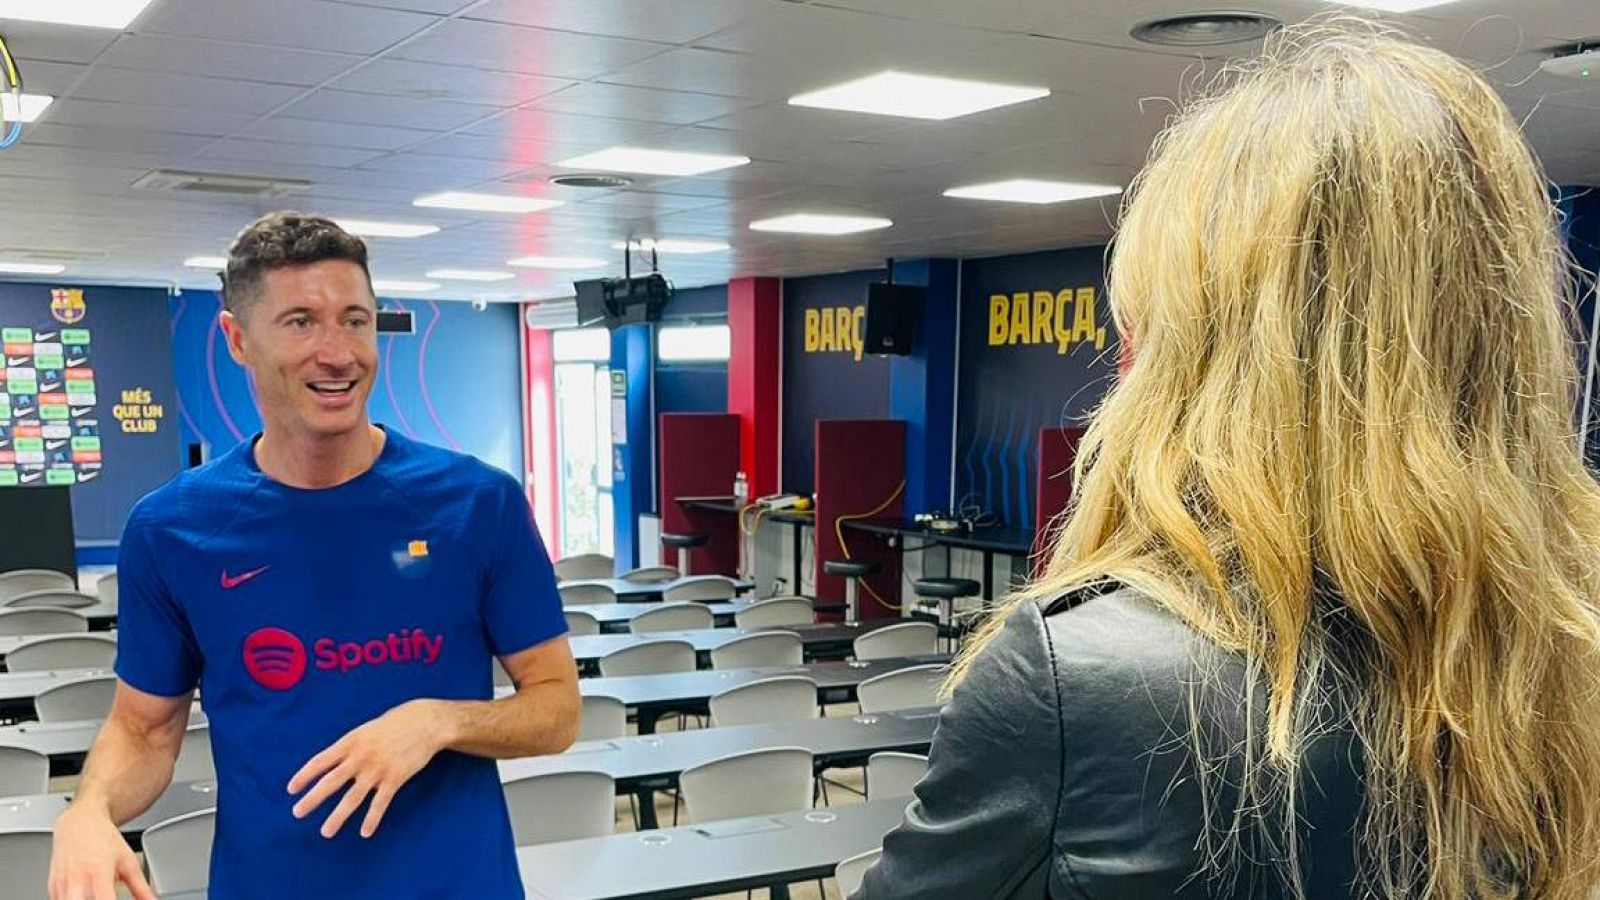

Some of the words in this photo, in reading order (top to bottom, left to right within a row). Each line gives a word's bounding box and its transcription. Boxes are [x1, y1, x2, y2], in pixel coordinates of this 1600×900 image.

[989, 287, 1106, 354] BARÇA,
[121, 388, 151, 404] MÉS
[113, 405, 141, 420] QUE
[142, 405, 163, 418] UN
[122, 419, 157, 433] CLUB
[314, 628, 444, 673] Spotify
